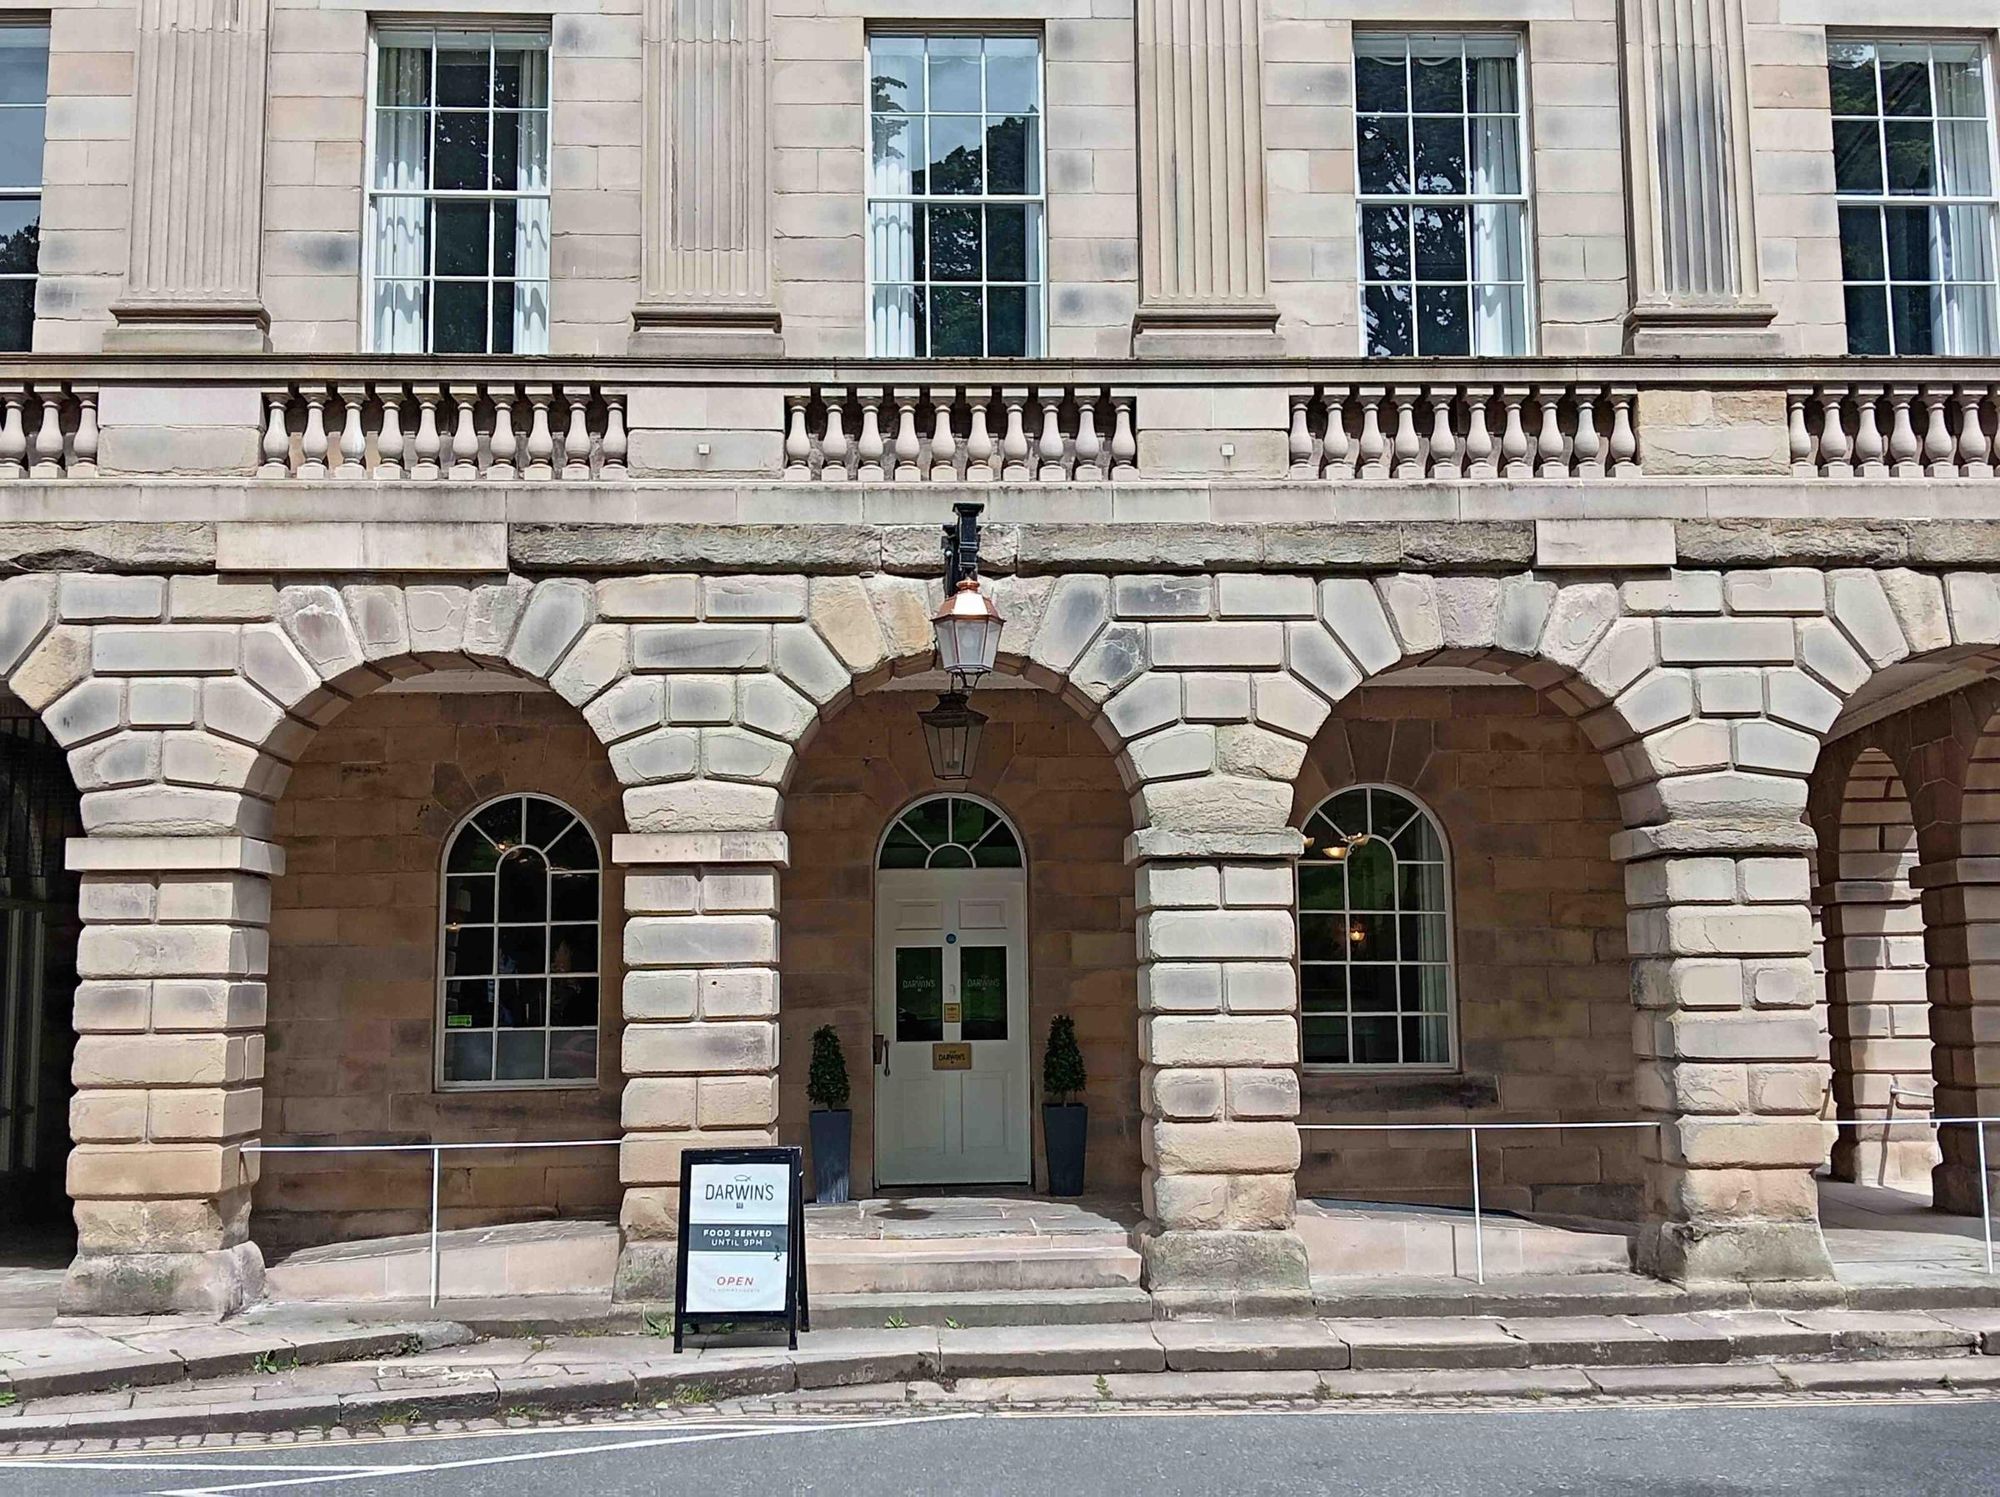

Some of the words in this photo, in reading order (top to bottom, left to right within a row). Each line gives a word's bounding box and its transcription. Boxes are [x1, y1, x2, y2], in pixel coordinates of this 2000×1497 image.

[705, 1182, 775, 1201] DARWIN'S
[703, 1229, 731, 1238] FOOD
[734, 1229, 772, 1238] SERVED
[711, 1239, 740, 1247] UNTIL
[743, 1239, 763, 1247] 9PM
[716, 1276, 754, 1286] OPEN
